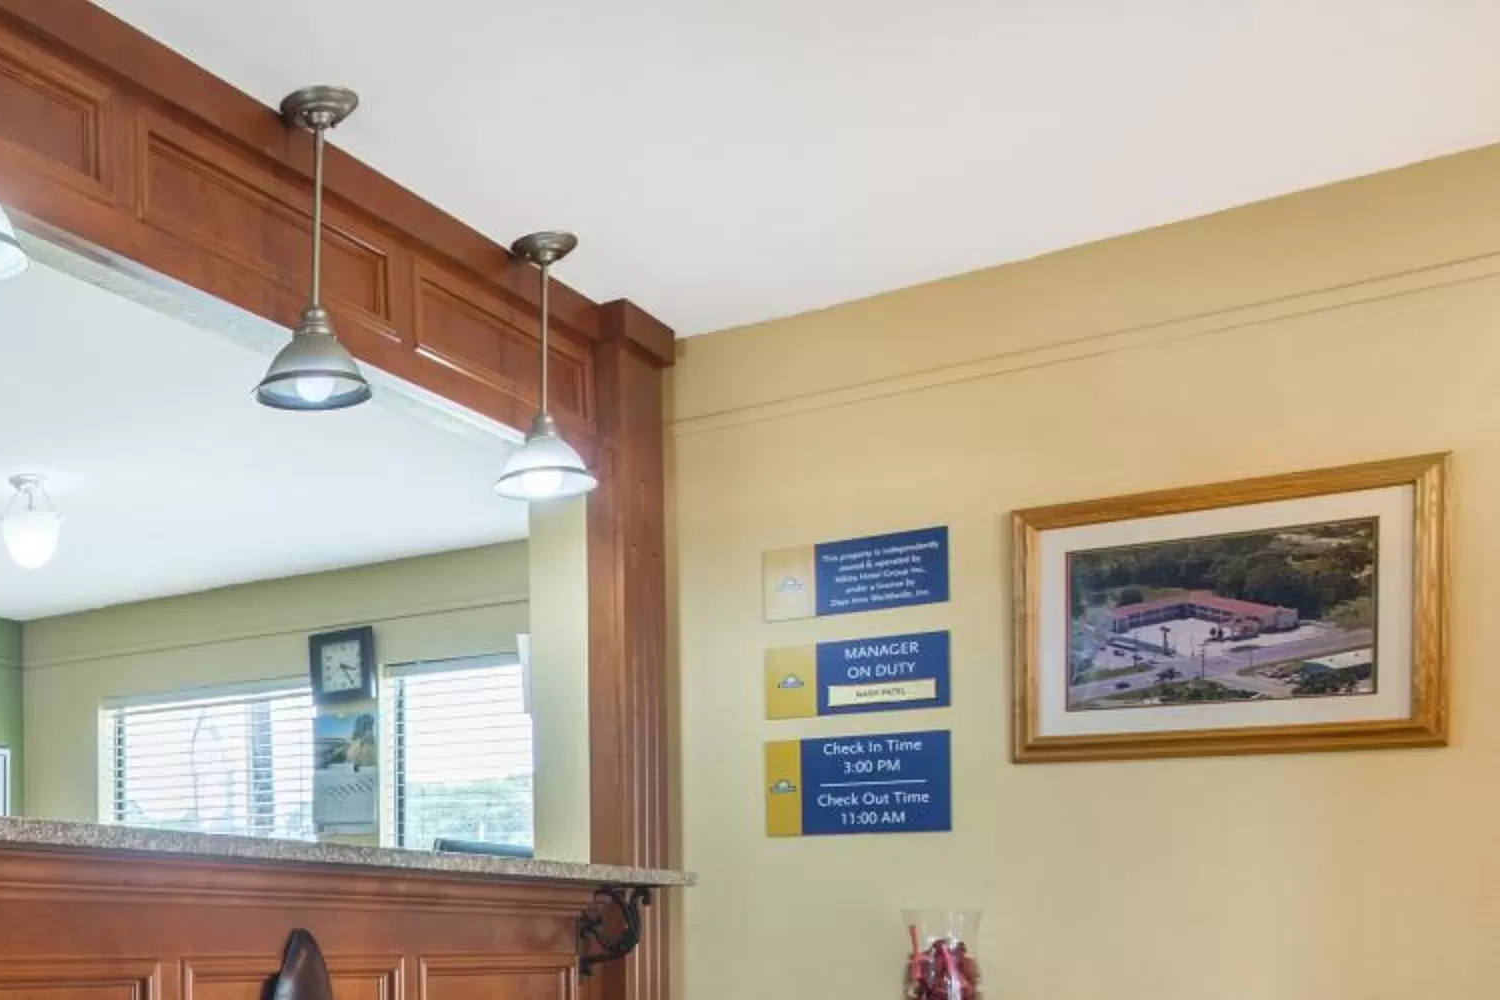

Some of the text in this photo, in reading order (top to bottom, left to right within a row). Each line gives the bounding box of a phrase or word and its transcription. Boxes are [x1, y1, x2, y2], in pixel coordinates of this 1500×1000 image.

[844, 641, 920, 660] MANAGER
[847, 661, 916, 679] ON DUTY
[823, 739, 923, 756] Check In Time
[843, 759, 900, 774] 3:00 PM
[817, 790, 930, 807] Check Out Time
[841, 811, 906, 825] 11:00 AM
